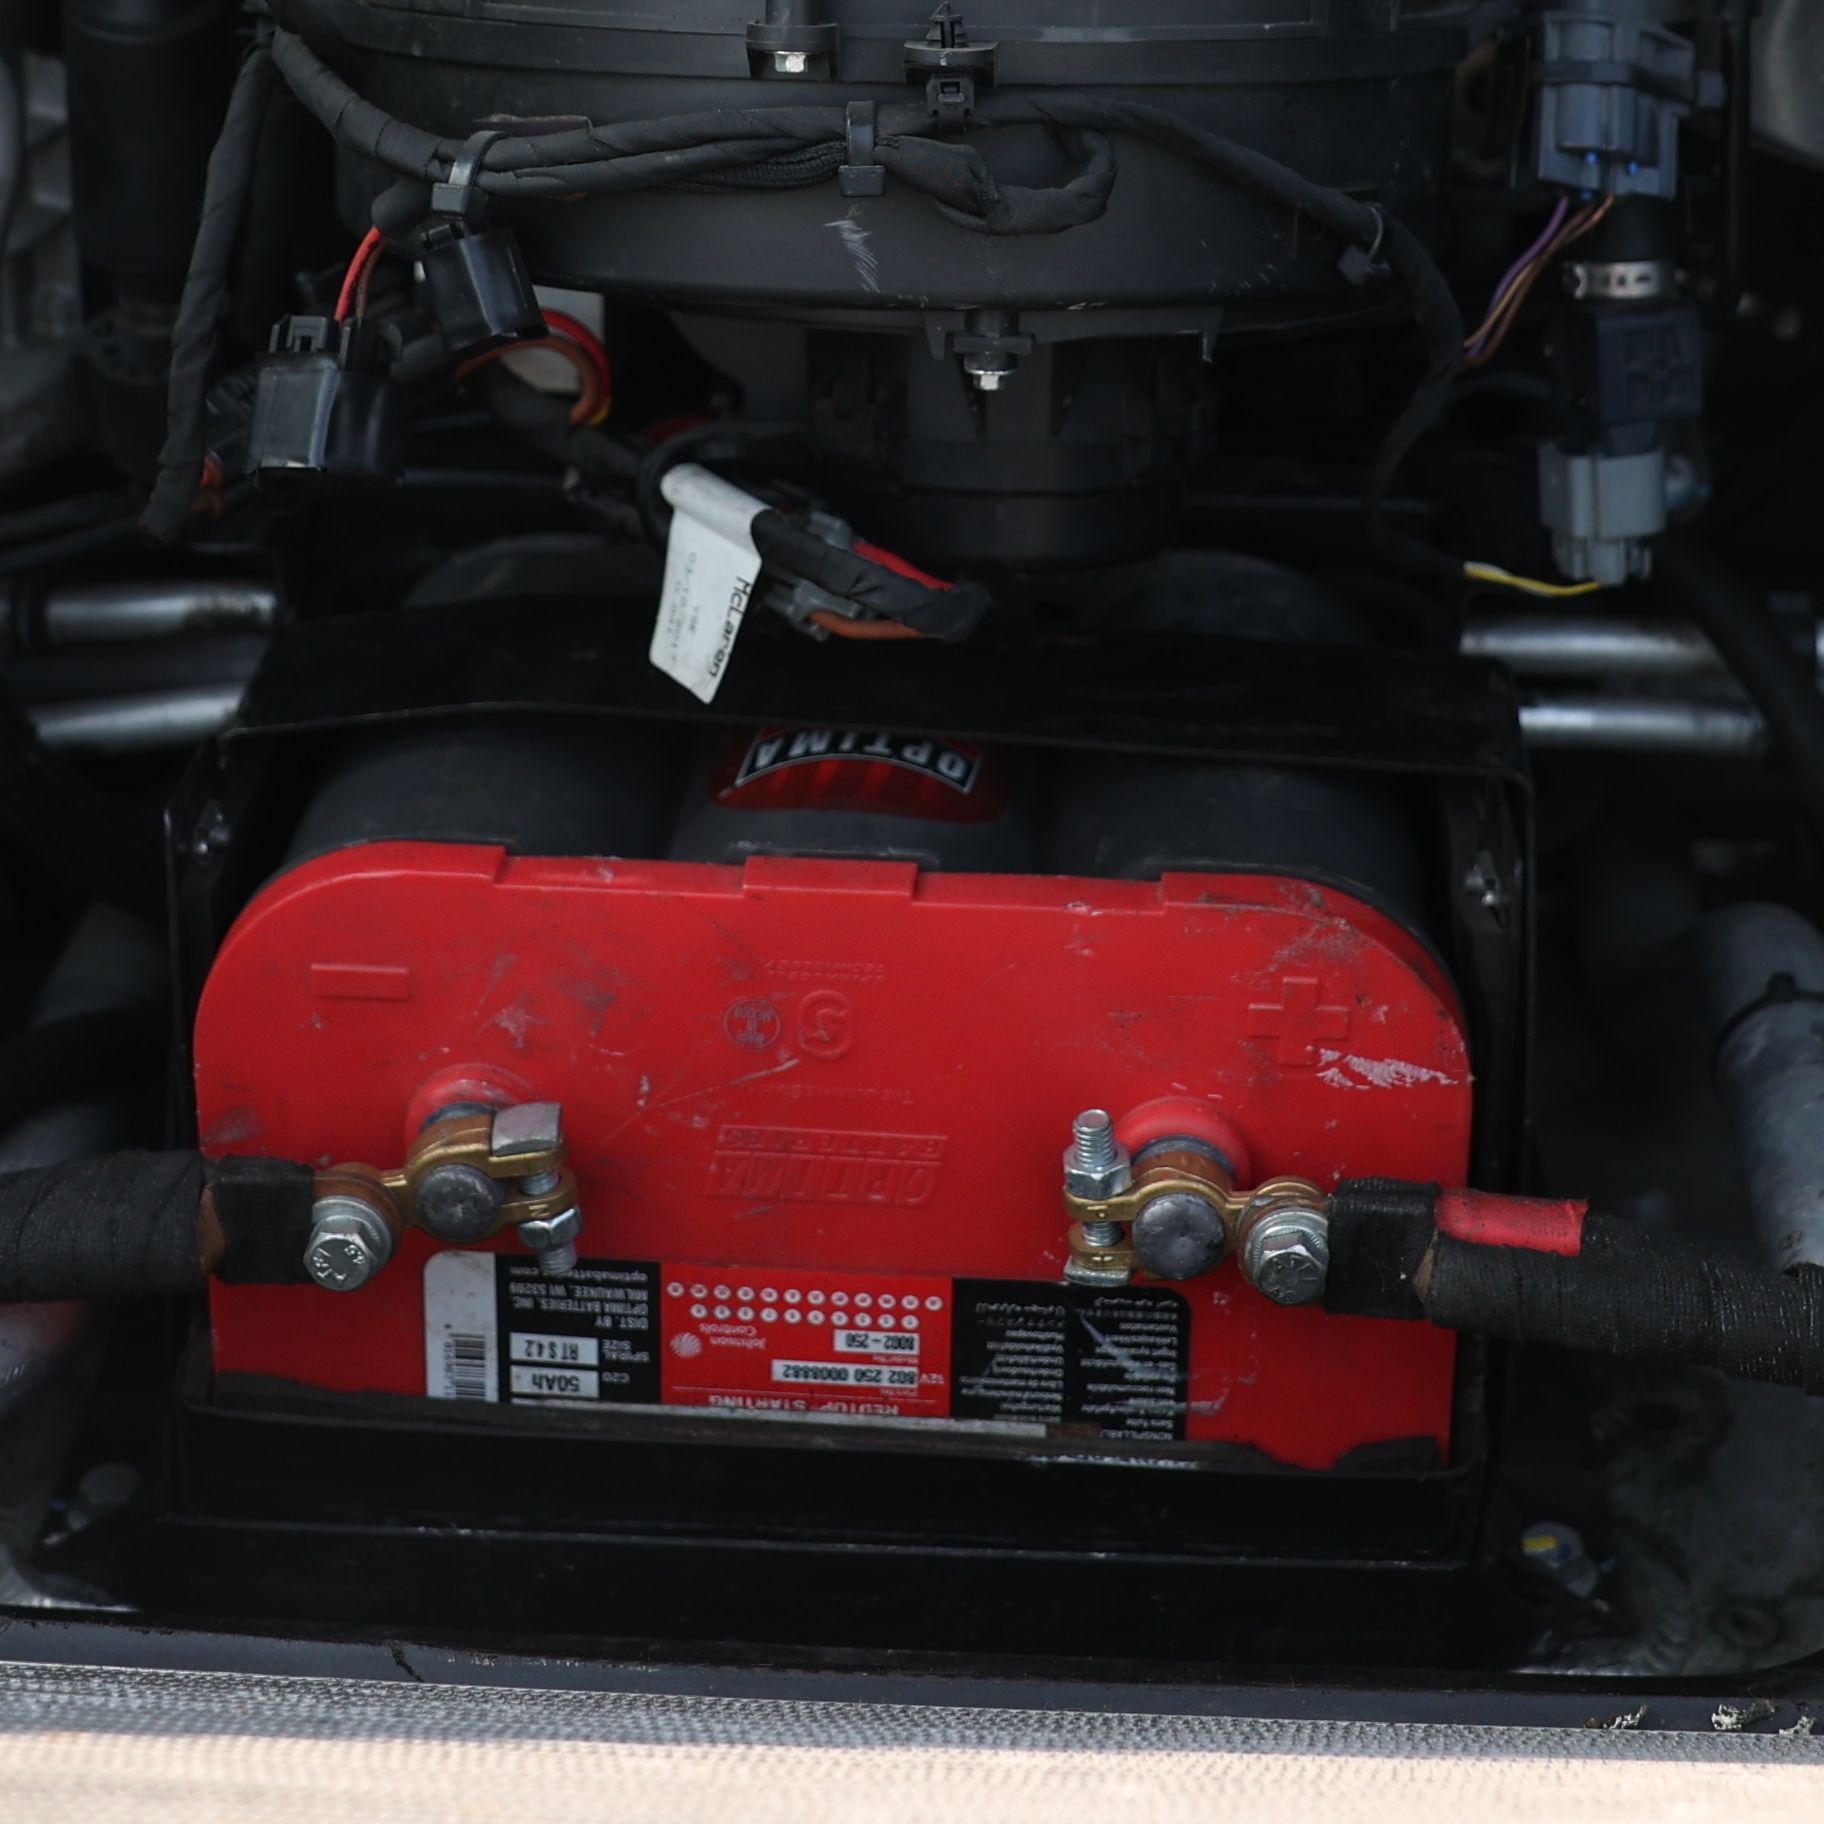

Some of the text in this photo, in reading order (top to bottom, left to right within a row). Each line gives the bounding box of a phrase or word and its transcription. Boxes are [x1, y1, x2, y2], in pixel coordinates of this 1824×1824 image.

[711, 576, 753, 679] McLaren
[753, 729, 968, 782] OPTIMA
[547, 1284, 567, 1298] WI
[602, 1299, 650, 1315] OPTIMA
[593, 1315, 613, 1329] BY
[699, 1322, 758, 1337] Controls
[601, 1338, 632, 1350] SIZE
[708, 1335, 768, 1350] Johnson
[562, 1342, 579, 1361] RT
[601, 1348, 651, 1363] SPIRAL
[531, 1372, 581, 1394] 50Ah
[853, 1368, 882, 1386] 250
